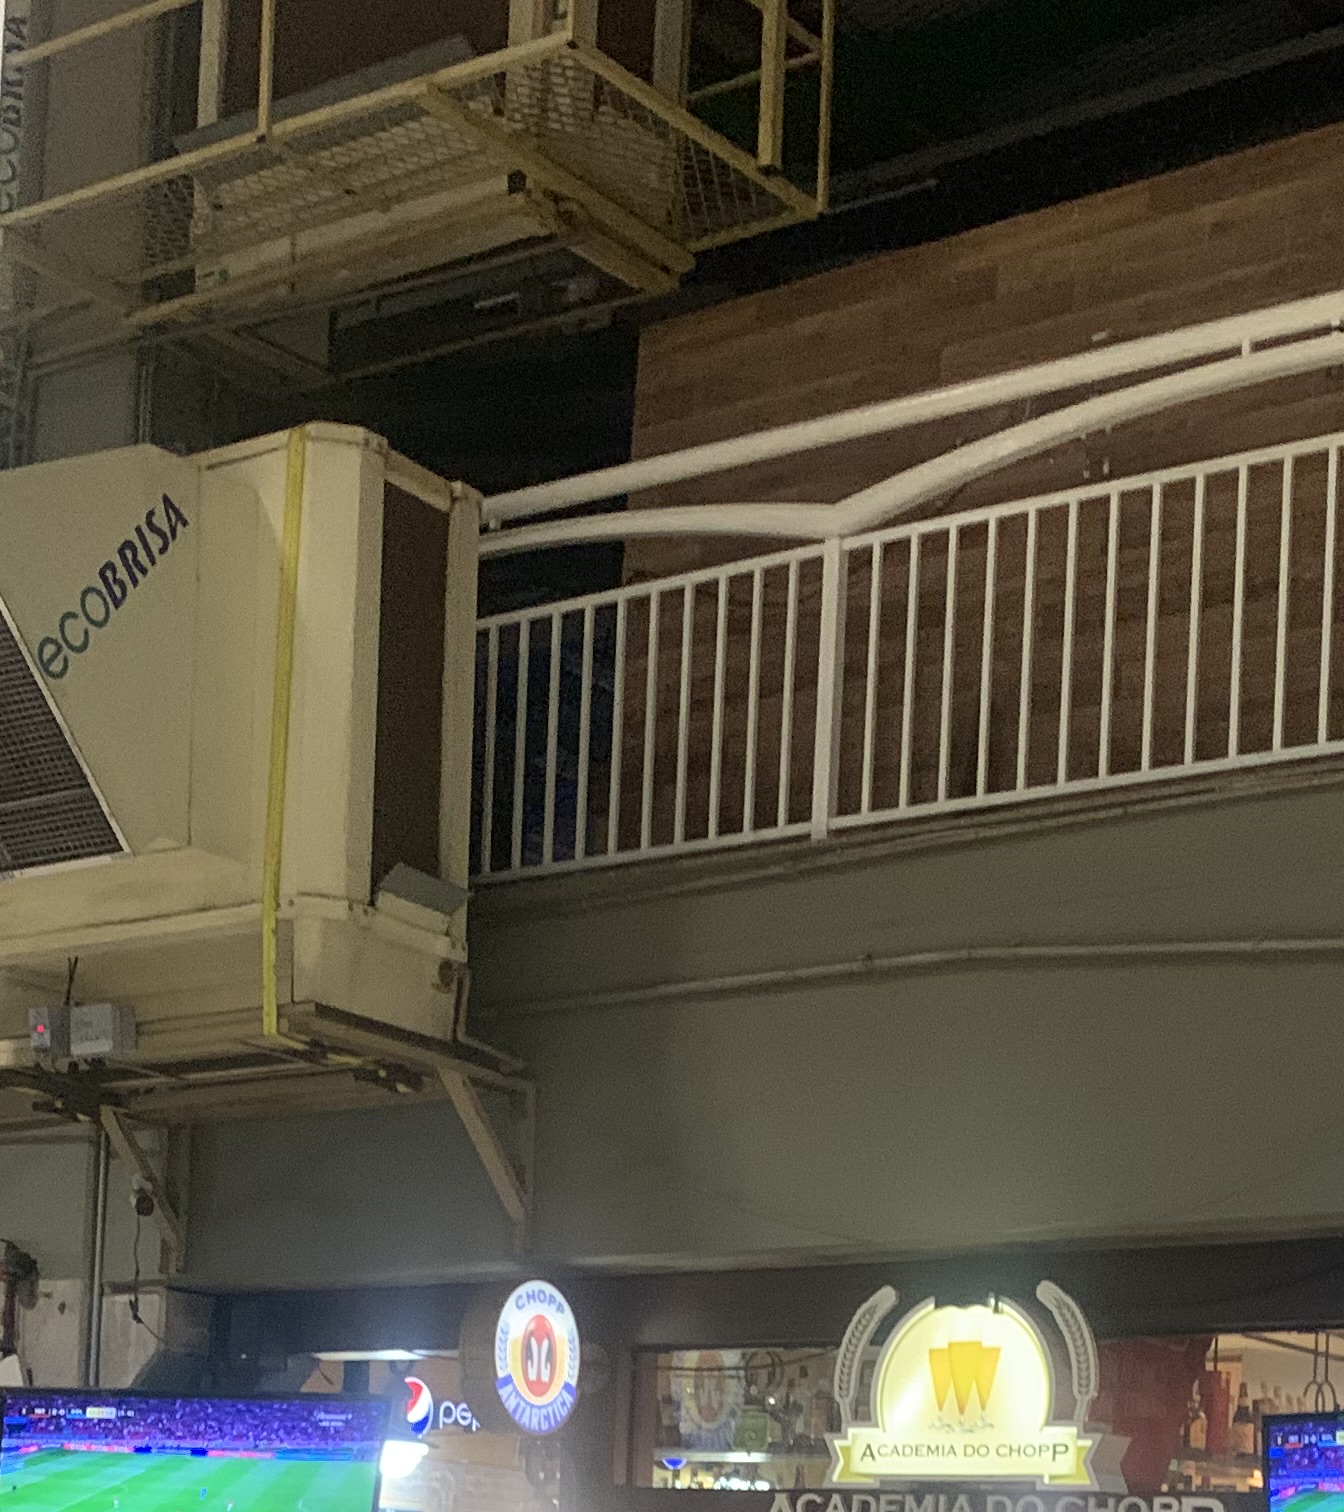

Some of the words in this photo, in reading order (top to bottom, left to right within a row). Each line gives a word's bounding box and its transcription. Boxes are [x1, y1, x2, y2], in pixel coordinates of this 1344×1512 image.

[36, 491, 190, 680] ecoBRISA
[515, 1289, 565, 1314] CHOPP
[501, 1384, 574, 1432] ANTARCTICA
[860, 1443, 957, 1462] ACADEMIA
[963, 1444, 990, 1458] DO
[995, 1443, 1069, 1462] CHOPP
